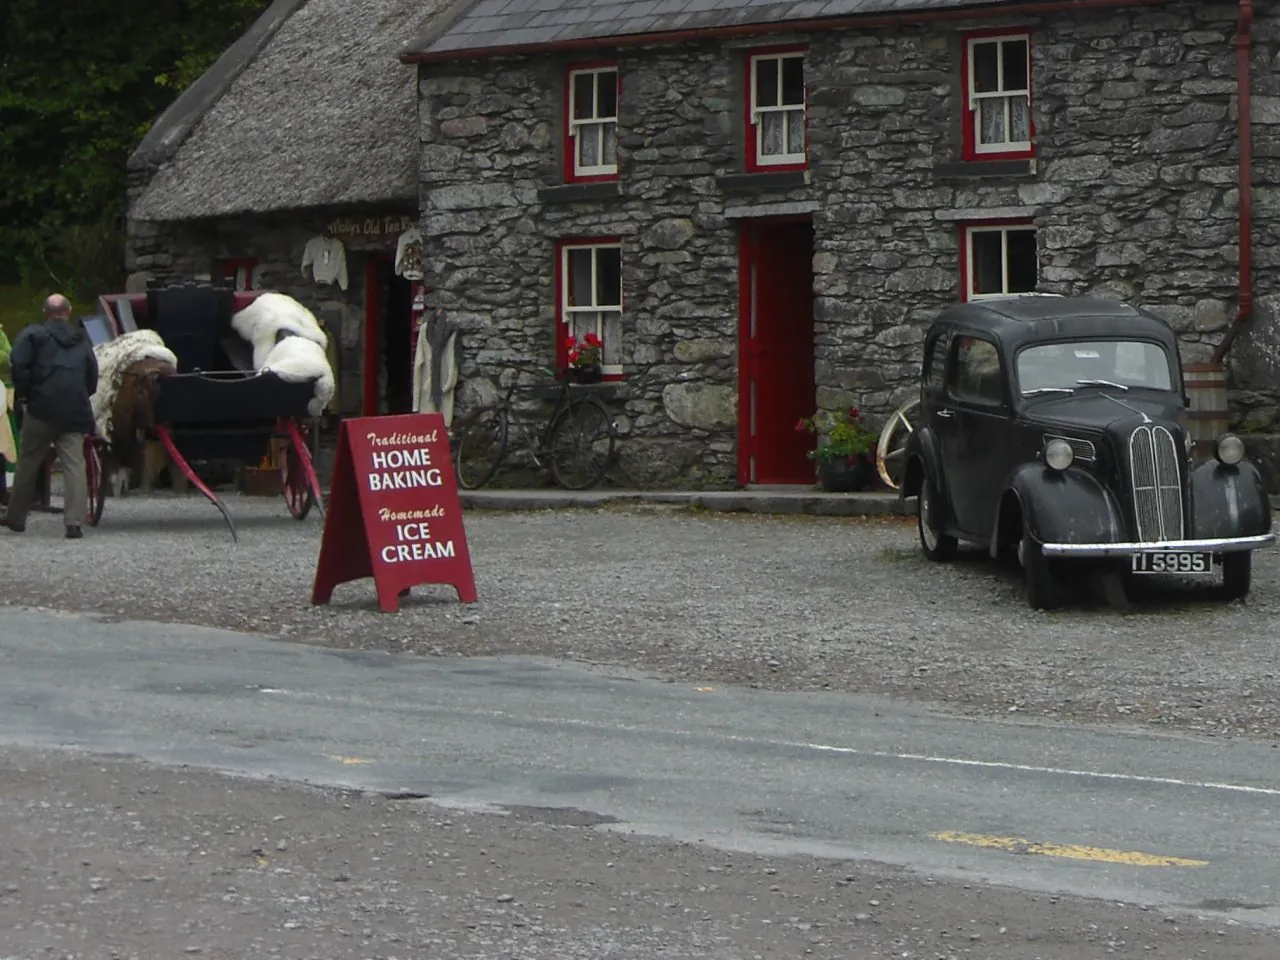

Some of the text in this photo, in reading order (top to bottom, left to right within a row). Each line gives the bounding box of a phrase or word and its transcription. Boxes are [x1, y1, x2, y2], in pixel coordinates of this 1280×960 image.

[363, 219, 380, 234] Old
[367, 429, 438, 446] Traditional
[372, 448, 431, 469] HOME
[368, 468, 443, 491] BAKING
[378, 504, 445, 521] Homemade
[396, 522, 431, 542] ICE
[381, 540, 456, 563] CREAM
[1152, 553, 1205, 571] 5995
